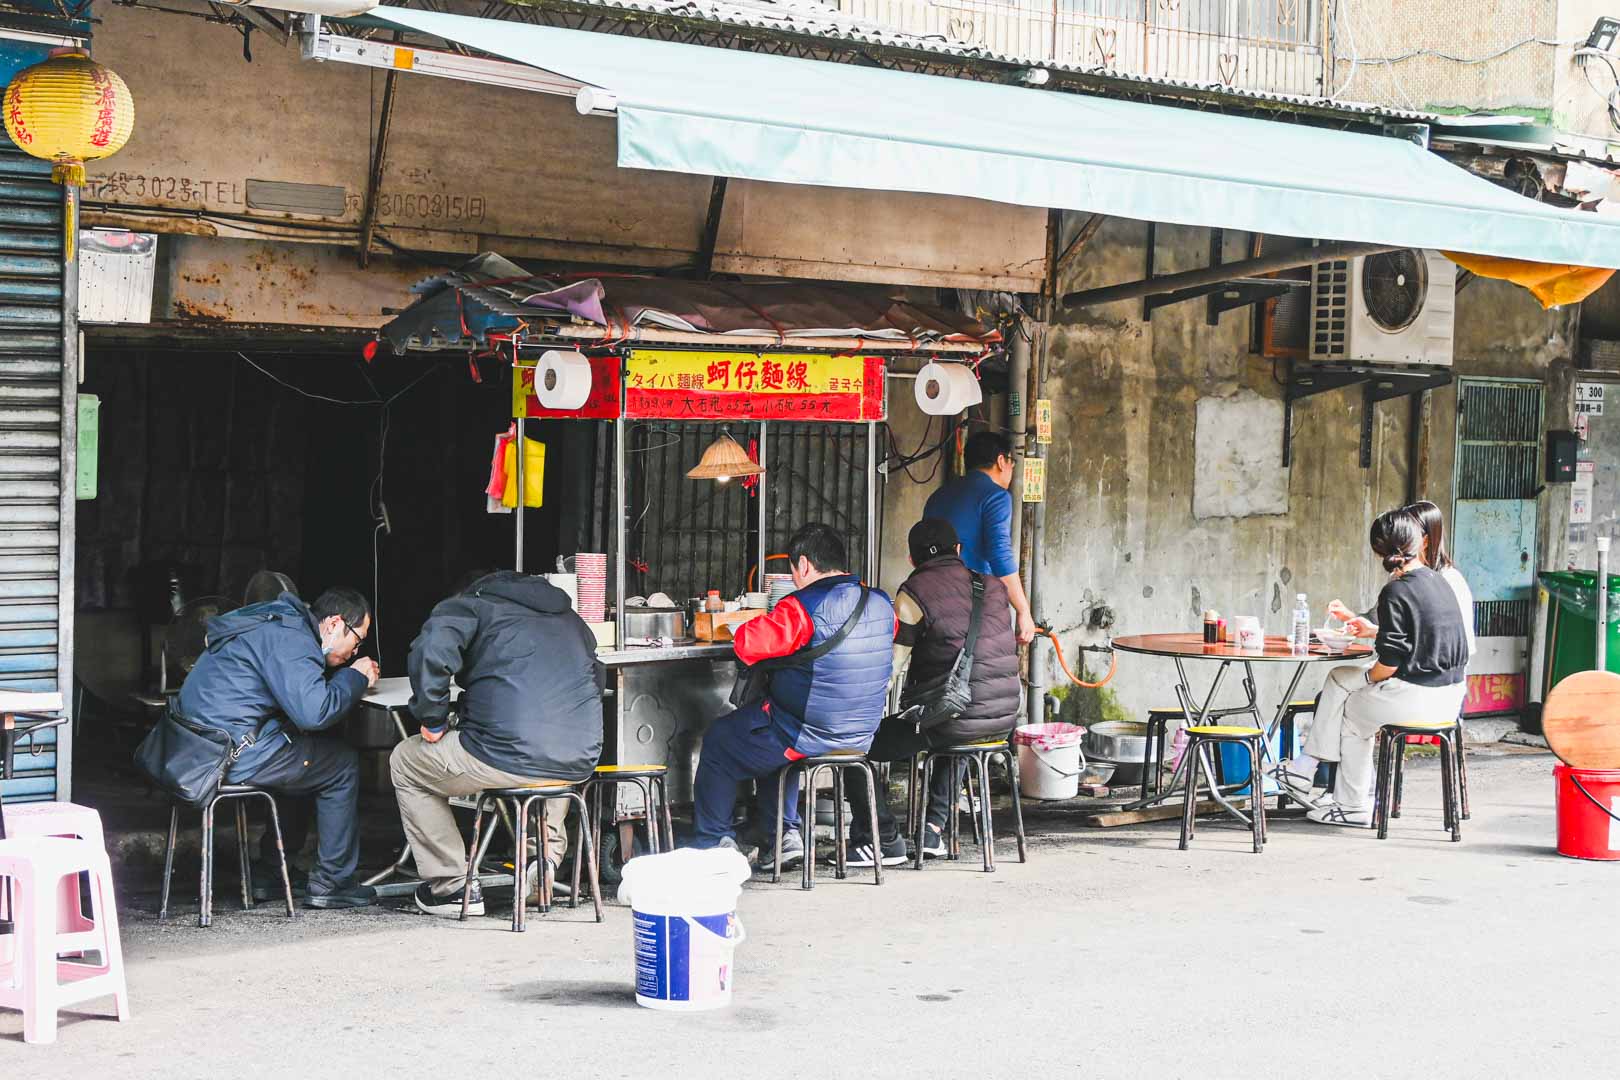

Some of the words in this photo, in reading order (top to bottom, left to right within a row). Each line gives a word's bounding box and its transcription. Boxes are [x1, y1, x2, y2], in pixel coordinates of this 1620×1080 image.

[199, 180, 244, 205] TEL
[706, 360, 812, 391] 蚵仔麵線
[829, 377, 863, 392] 굴국수
[1588, 386, 1603, 398] 300
